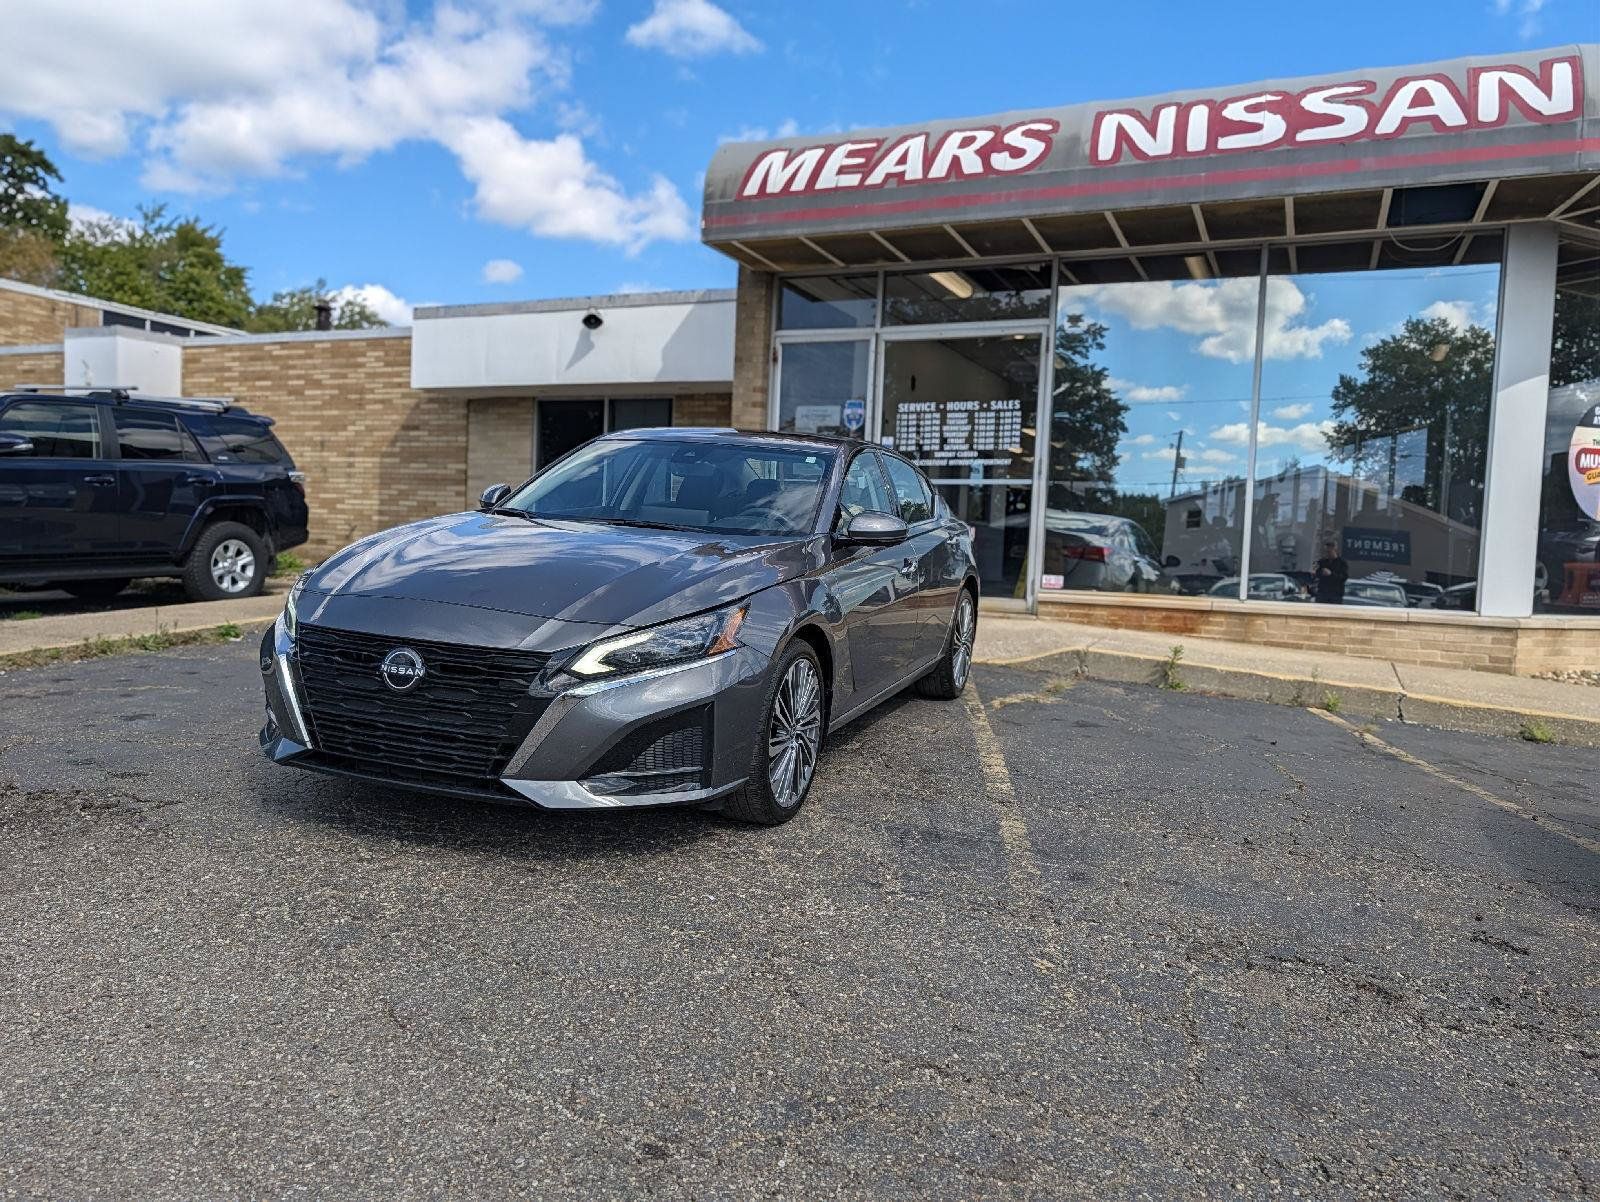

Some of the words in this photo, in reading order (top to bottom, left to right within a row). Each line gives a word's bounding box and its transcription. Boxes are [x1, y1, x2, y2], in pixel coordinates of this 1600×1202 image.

[743, 123, 1053, 197] MEARS
[1098, 61, 1574, 161] NISSAN
[898, 402, 936, 412] SERVICE
[946, 401, 980, 411] HOURS
[990, 400, 1020, 410] SALES
[381, 664, 425, 677] NISSAN
